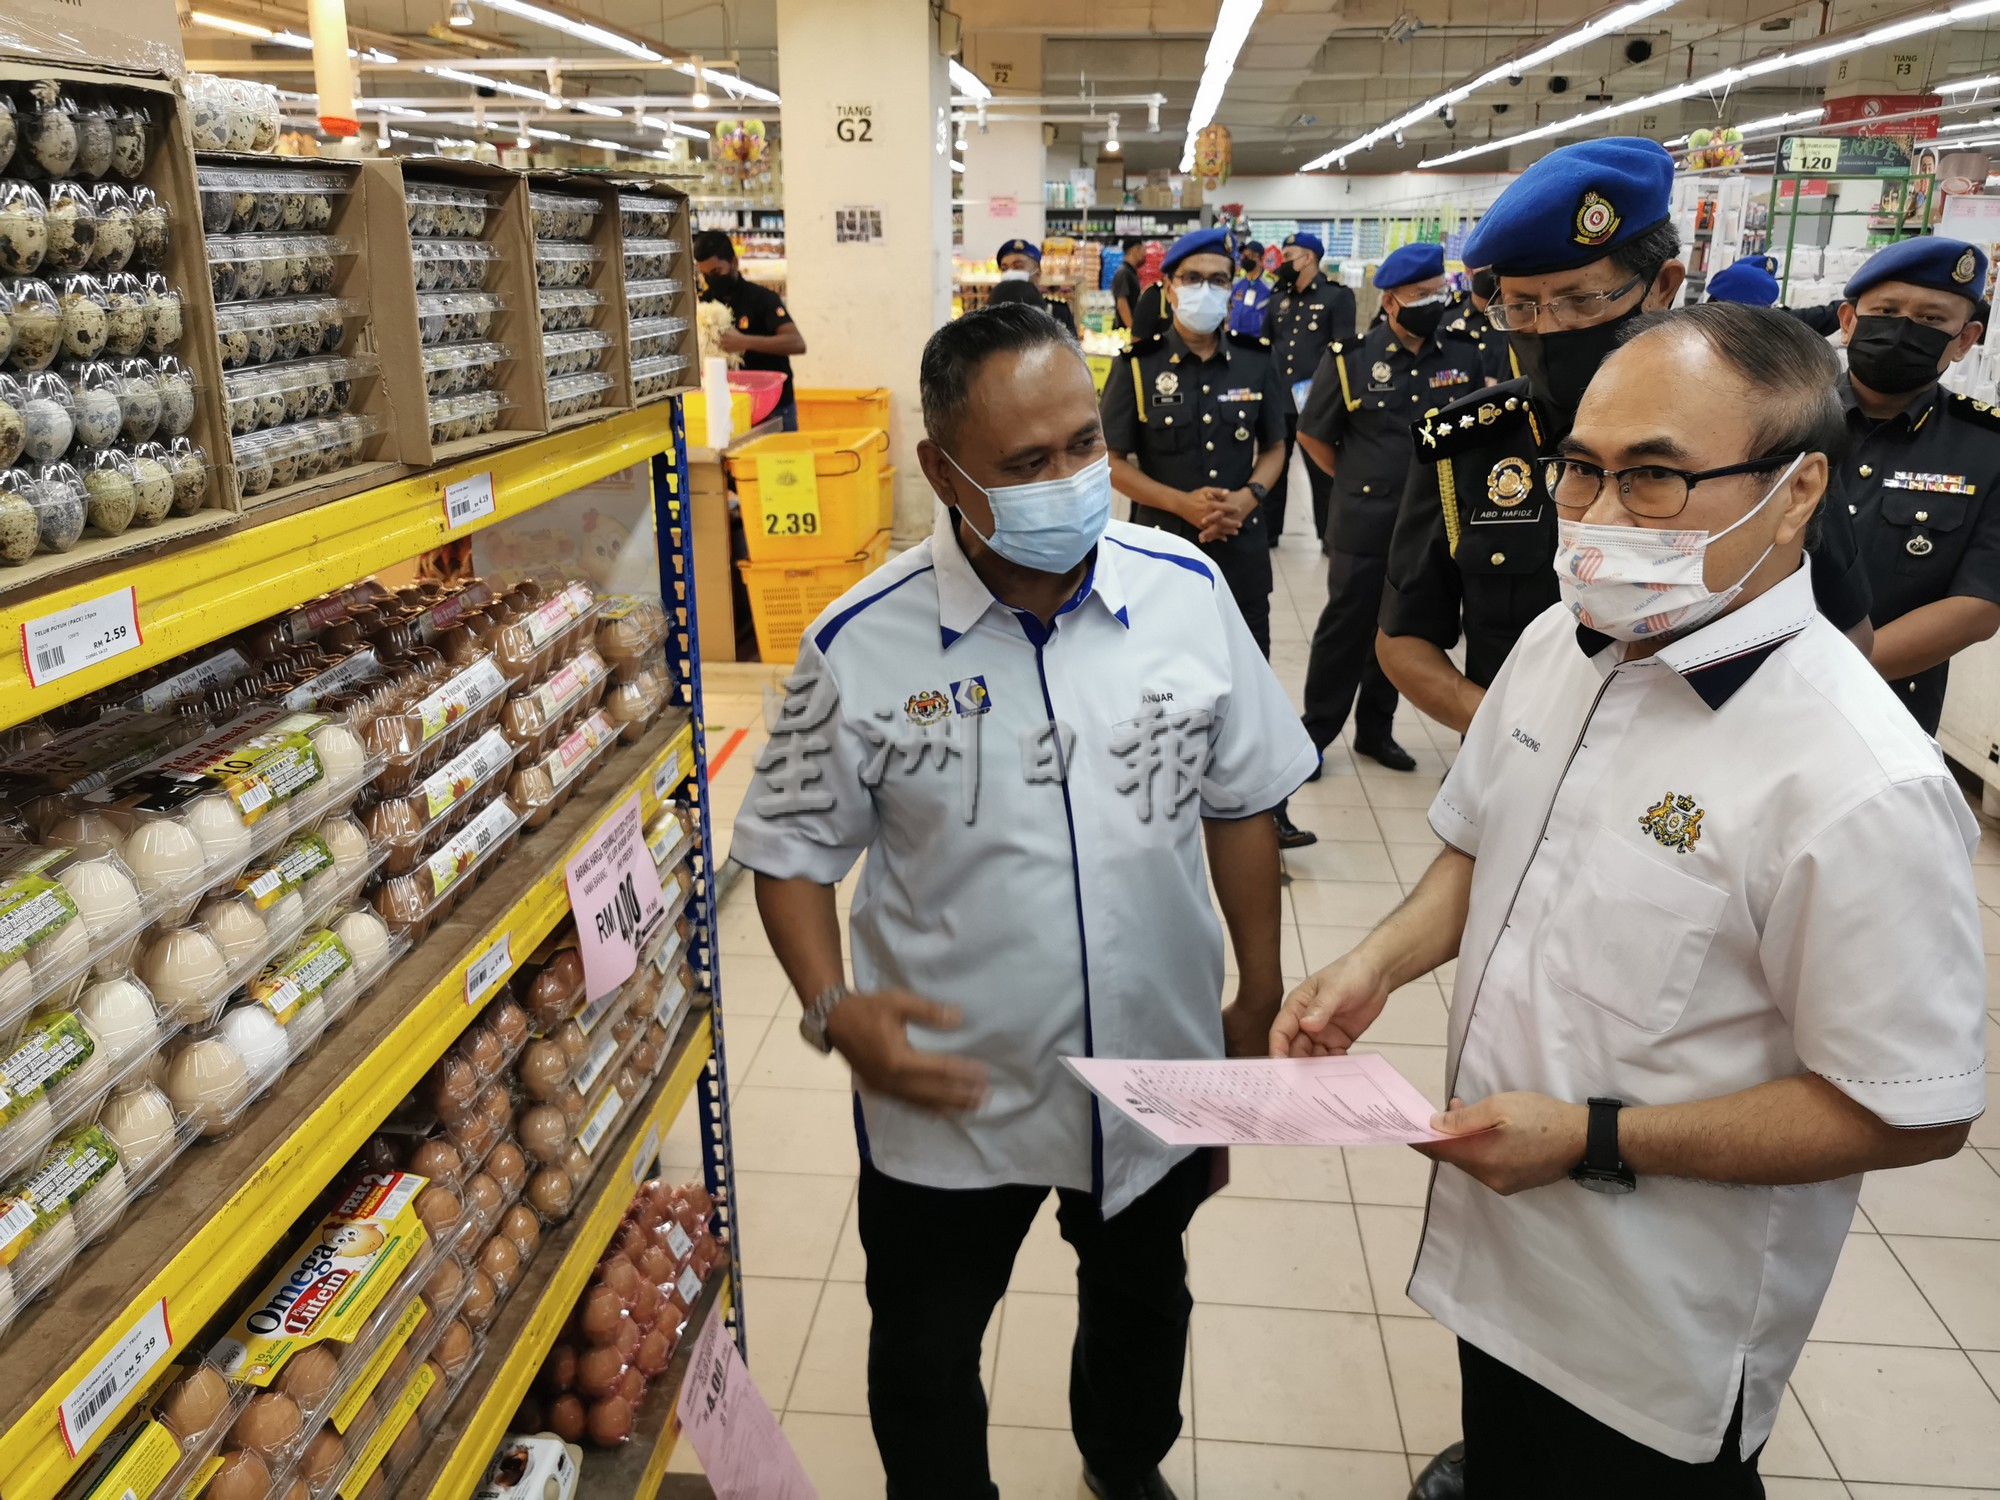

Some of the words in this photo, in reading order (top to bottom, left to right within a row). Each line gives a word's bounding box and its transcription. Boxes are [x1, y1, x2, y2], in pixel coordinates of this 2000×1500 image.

[995, 72, 1008, 82] F2
[1896, 64, 1911, 74] F3
[836, 106, 872, 116] TIANG
[837, 118, 872, 142] G2
[1800, 156, 1832, 170] 1.20
[766, 513, 817, 534] 2.39
[1633, 592, 1663, 612] MALAYSIA
[34, 627, 50, 638] TELUR
[51, 623, 66, 632] PUYUH
[68, 616, 84, 627] (PACK)
[94, 640, 103, 649] RM
[104, 626, 126, 643] 2.59
[446, 682, 462, 698] FRESH
[466, 686, 482, 706] EGGS
[1142, 692, 1174, 704] ANUAR
[159, 749, 200, 770] Telur
[198, 724, 250, 750] Rumah
[246, 709, 280, 731] Saya
[212, 760, 253, 775] 10
[452, 756, 468, 773] FRESH
[473, 756, 488, 778] EGGS
[457, 830, 473, 847] FRESH
[476, 828, 491, 851] EGGS
[575, 863, 591, 882] BARANG
[589, 850, 602, 870] HARGA
[10, 908, 34, 928] FARMING
[596, 902, 617, 944] RM
[614, 872, 642, 946] 4.00
[15, 1066, 31, 1080] YUAN
[27, 1050, 51, 1071] FARMING
[40, 1181, 56, 1197] YUAN
[52, 1164, 75, 1186] FARMING
[338, 1184, 372, 1215] FREE
[363, 1174, 395, 1186] 2
[364, 1186, 388, 1212] PERCUMA
[246, 1242, 339, 1334] Omega
[286, 1271, 348, 1332] Lutein
[292, 1301, 308, 1317] Plus
[124, 1365, 134, 1378] RM
[135, 1336, 156, 1365] 5.39
[254, 1353, 266, 1362] 10
[267, 1340, 282, 1354] EGGS
[264, 1354, 274, 1362] +2
[71, 1391, 86, 1408] TELUR
[86, 1374, 102, 1392] RUMAH
[102, 1361, 114, 1376] SAYA
[129, 1331, 142, 1346] TELUR
